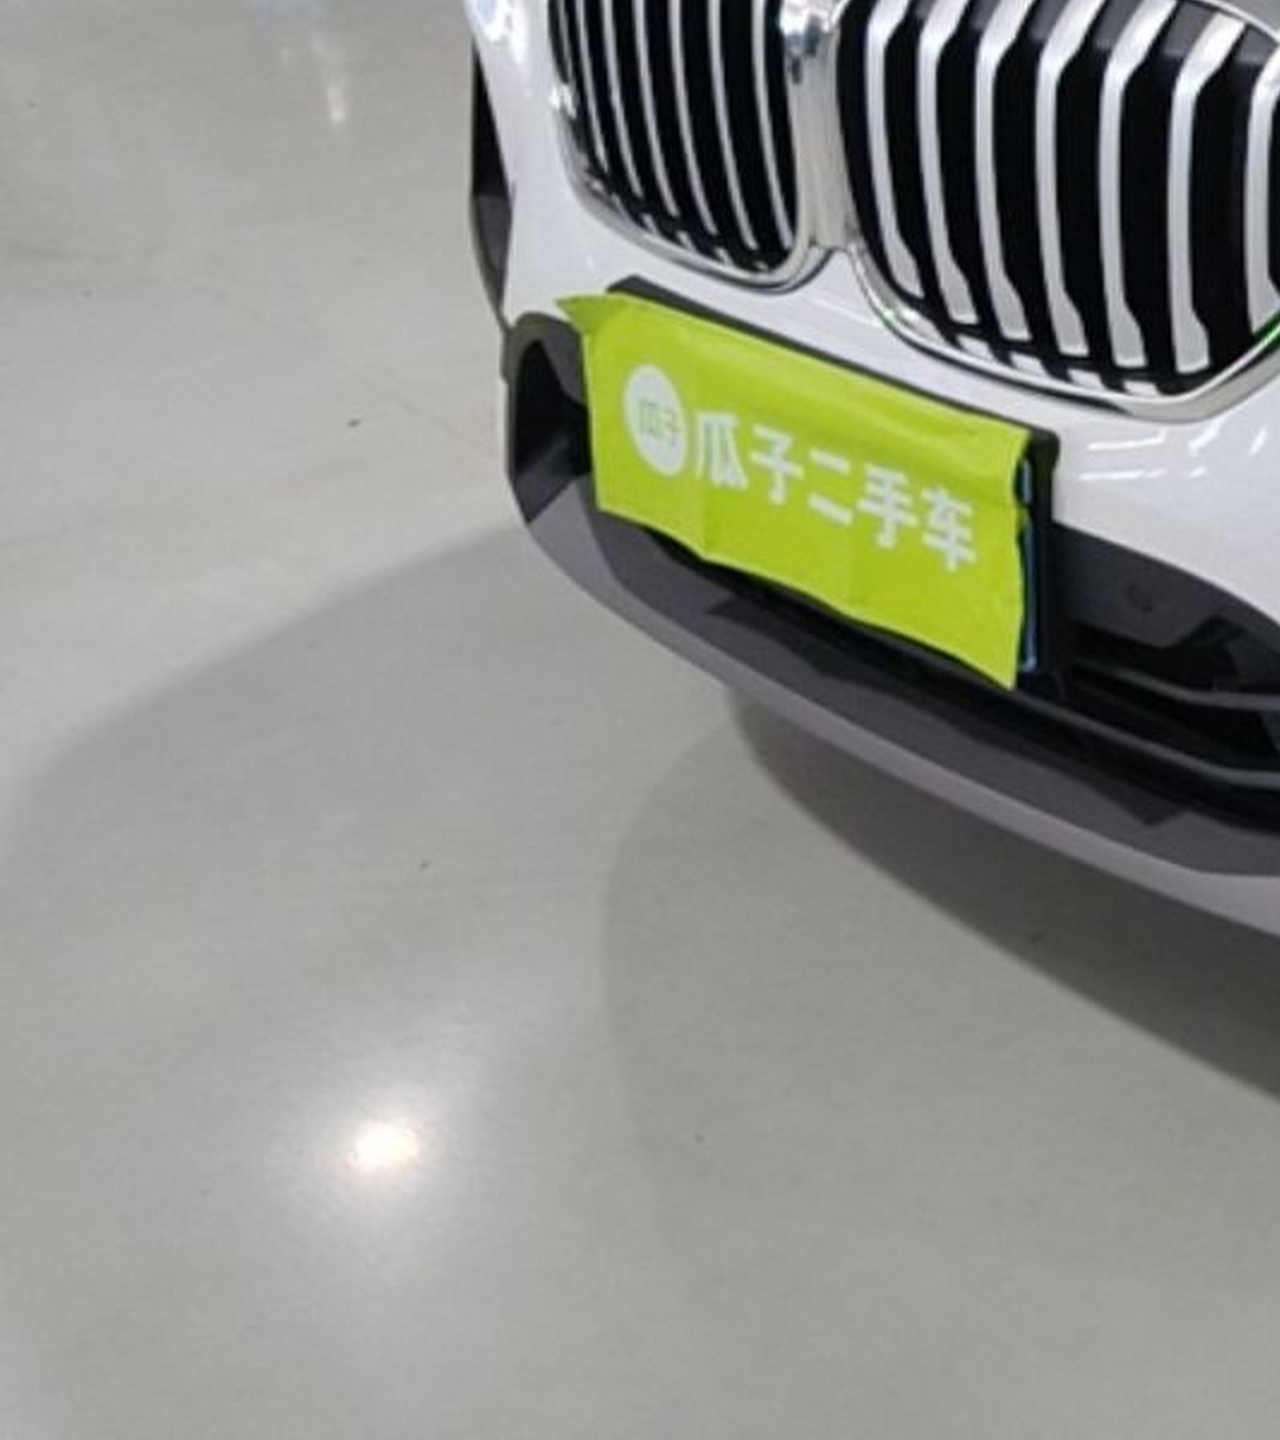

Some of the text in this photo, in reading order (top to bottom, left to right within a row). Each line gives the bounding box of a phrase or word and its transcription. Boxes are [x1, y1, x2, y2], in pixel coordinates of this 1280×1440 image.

[695, 411, 976, 572] 瓜子二手车
